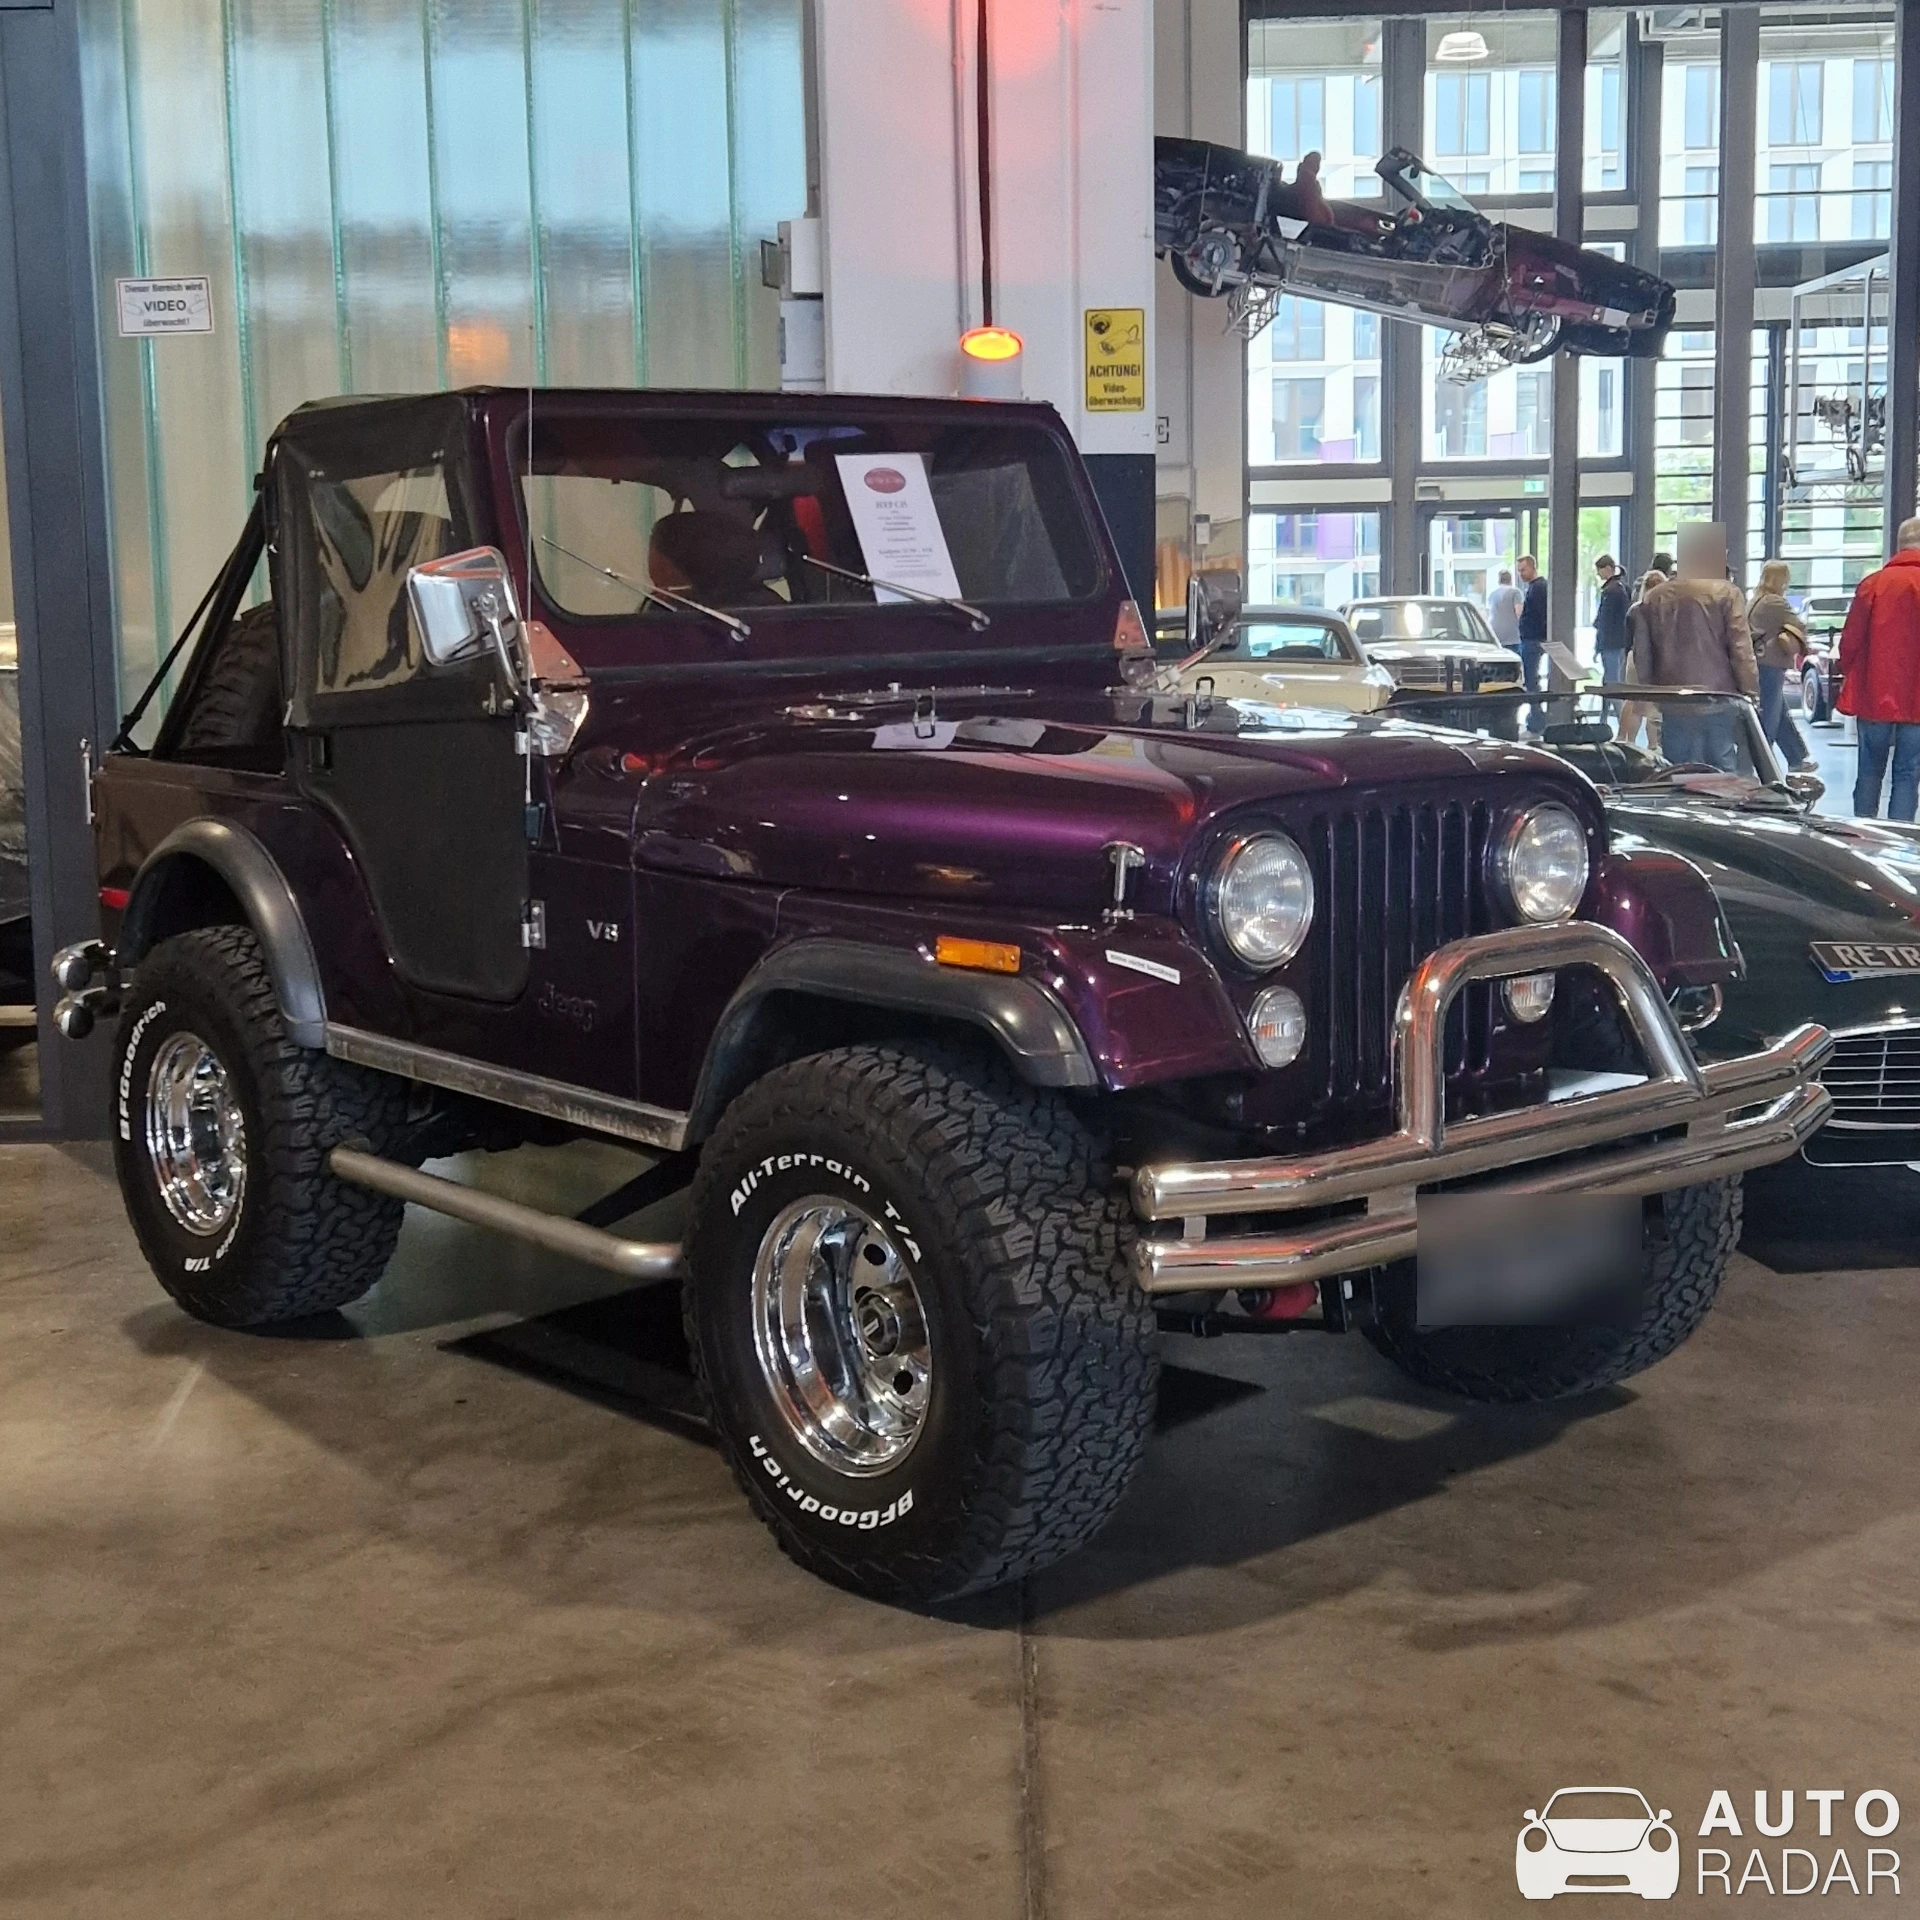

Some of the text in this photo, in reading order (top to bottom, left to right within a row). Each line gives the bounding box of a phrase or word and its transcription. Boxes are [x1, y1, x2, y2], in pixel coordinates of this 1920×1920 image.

[143, 299, 187, 312] VIDEO
[1089, 364, 1141, 377] ACHTUNG!
[1102, 382, 1128, 394] Video-
[586, 919, 620, 943] V8
[120, 1000, 167, 1141] BFGoodrich
[730, 1153, 922, 1263] All-Terrain T/A
[184, 1257, 212, 1273] T/A
[749, 1435, 915, 1530] BFGoodrich
